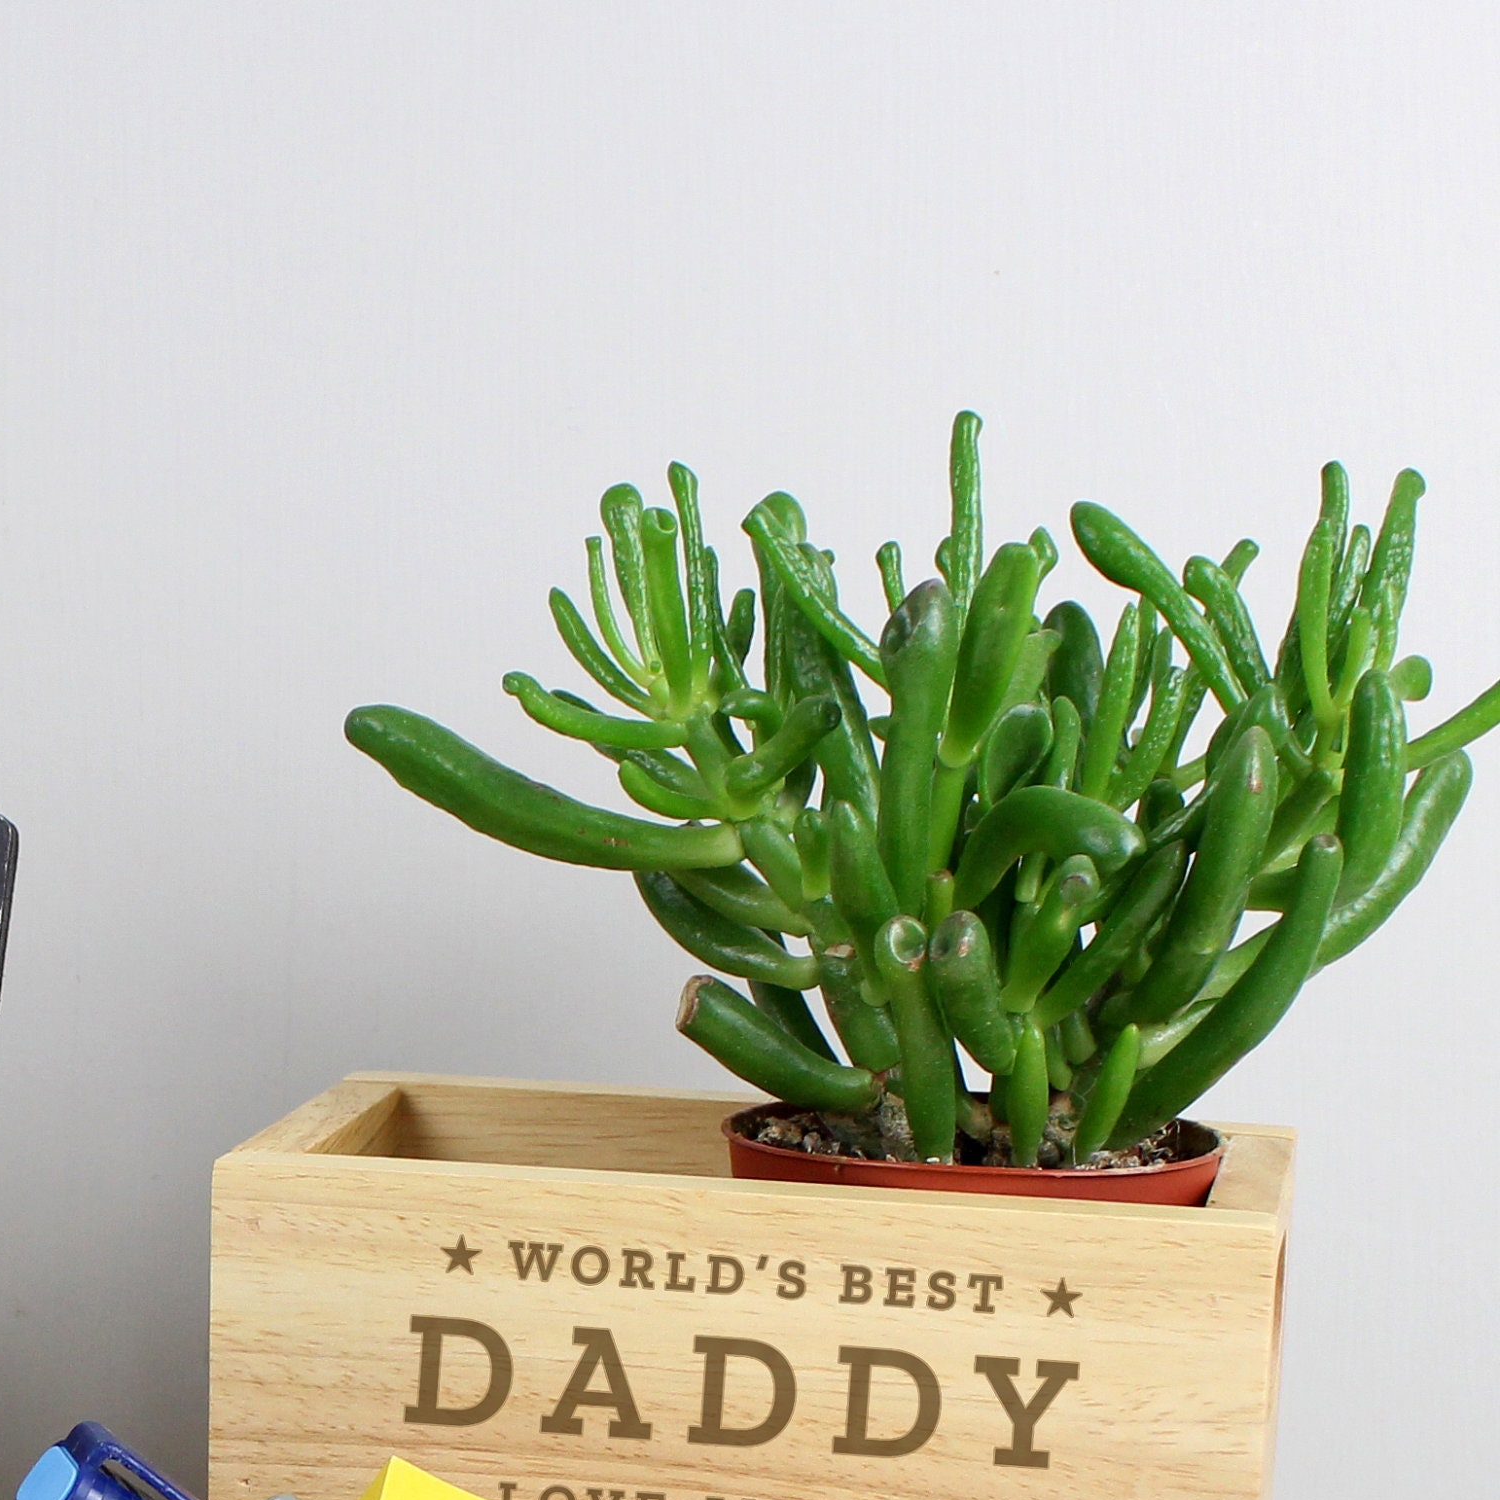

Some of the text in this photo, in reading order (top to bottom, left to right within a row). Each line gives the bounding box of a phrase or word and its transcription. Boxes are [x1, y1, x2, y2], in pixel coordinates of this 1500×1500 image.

[507, 1240, 1004, 1314] WORLD'S BEST
[402, 1314, 1081, 1470] DADDY
